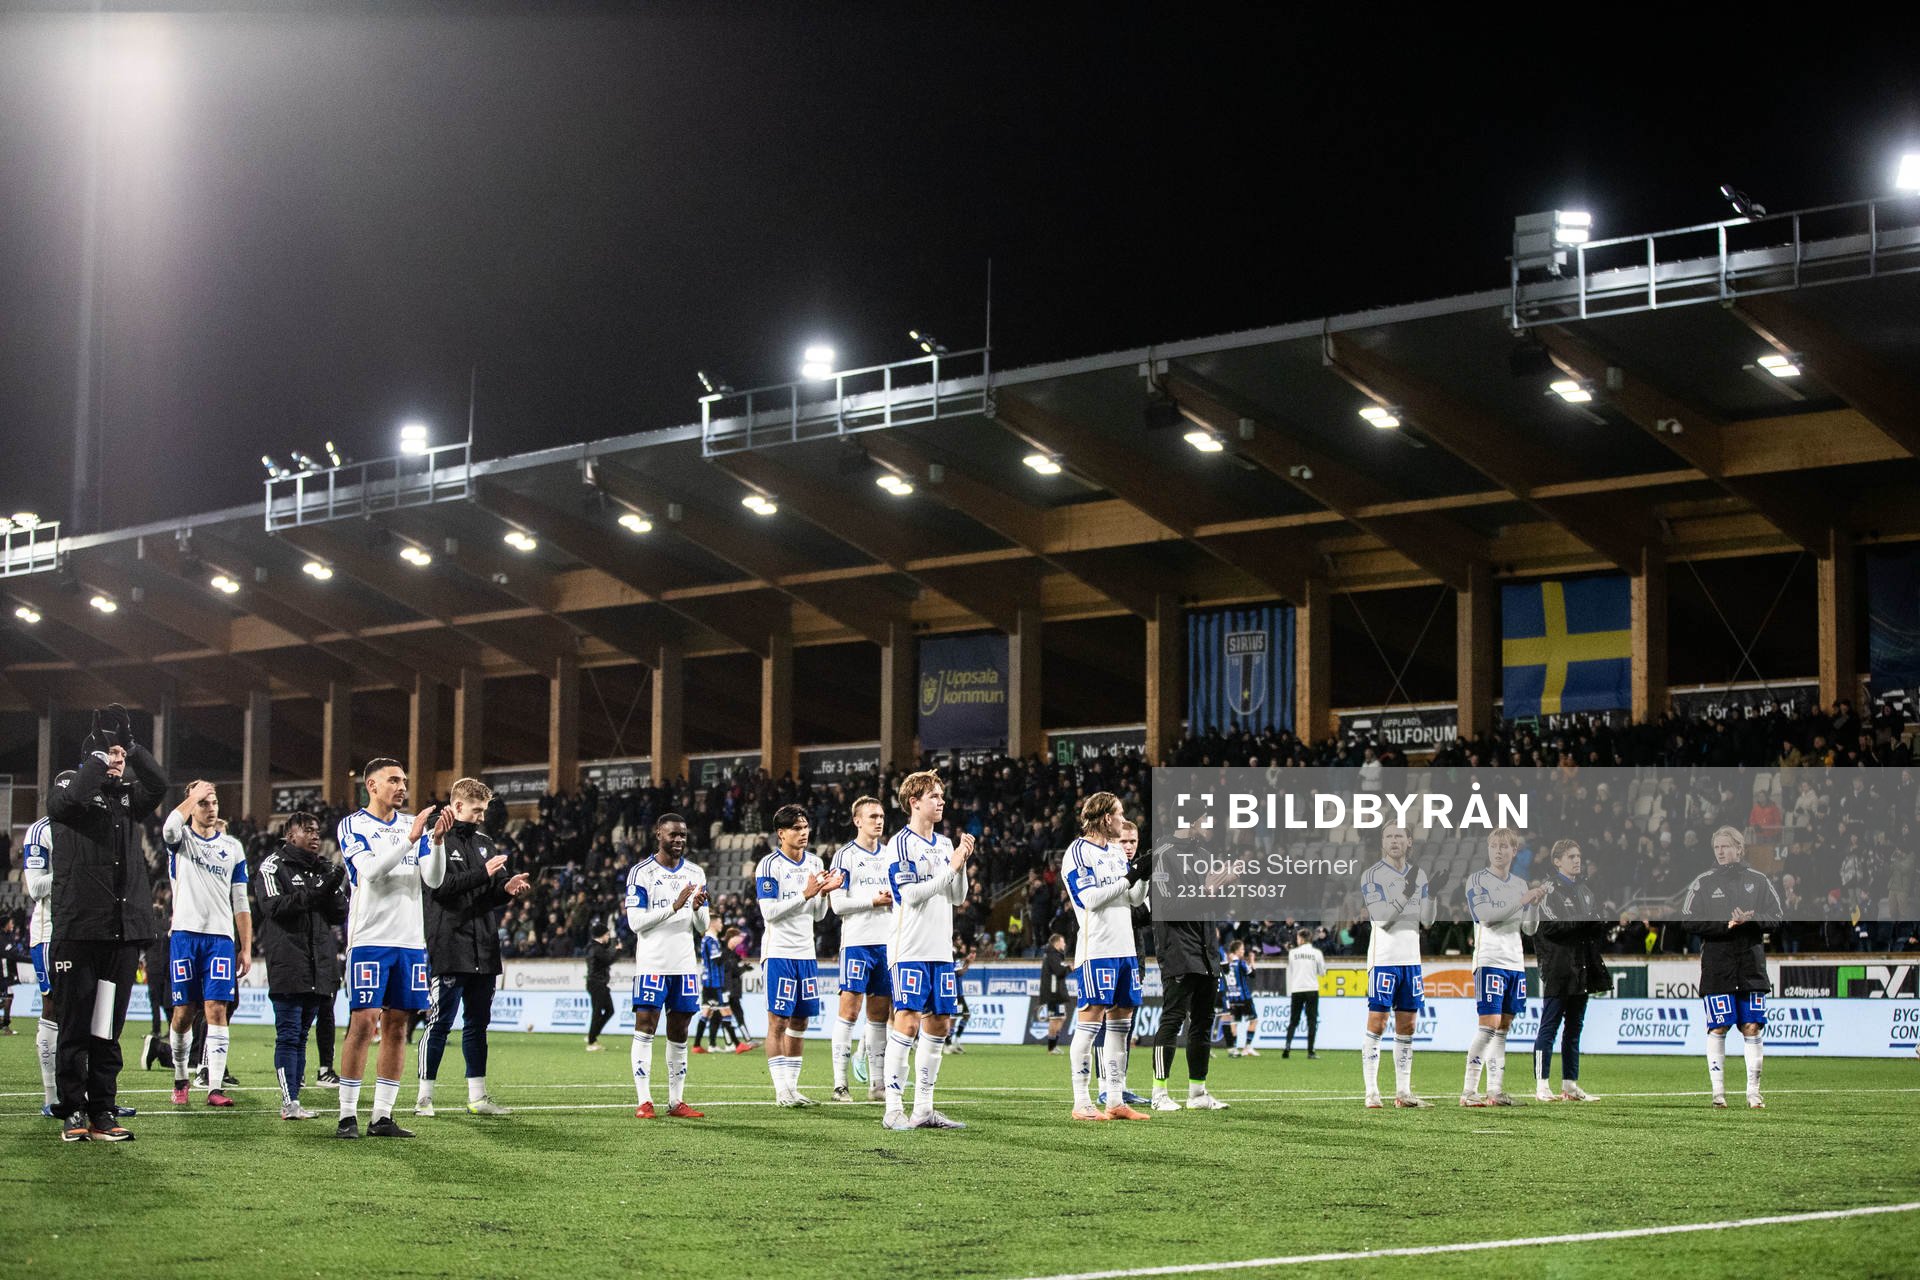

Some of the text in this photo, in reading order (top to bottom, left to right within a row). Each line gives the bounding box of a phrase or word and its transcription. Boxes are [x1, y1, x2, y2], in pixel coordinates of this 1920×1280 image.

[1229, 634, 1264, 653] SIRIUS
[946, 670, 999, 690] Uppsala
[943, 687, 1004, 706] kommun
[1382, 718, 1422, 728] UPPLANDS
[1082, 743, 1099, 759] Nu
[1773, 845, 1789, 861] 14
[55, 961, 73, 973] PP
[359, 991, 374, 1004] 37
[643, 991, 655, 1003] 23
[774, 1000, 786, 1011] 22
[1262, 1005, 1291, 1018] BYGG
[1621, 1007, 1654, 1021] BYGG
[1618, 1023, 1691, 1038] CONSTRUCT
